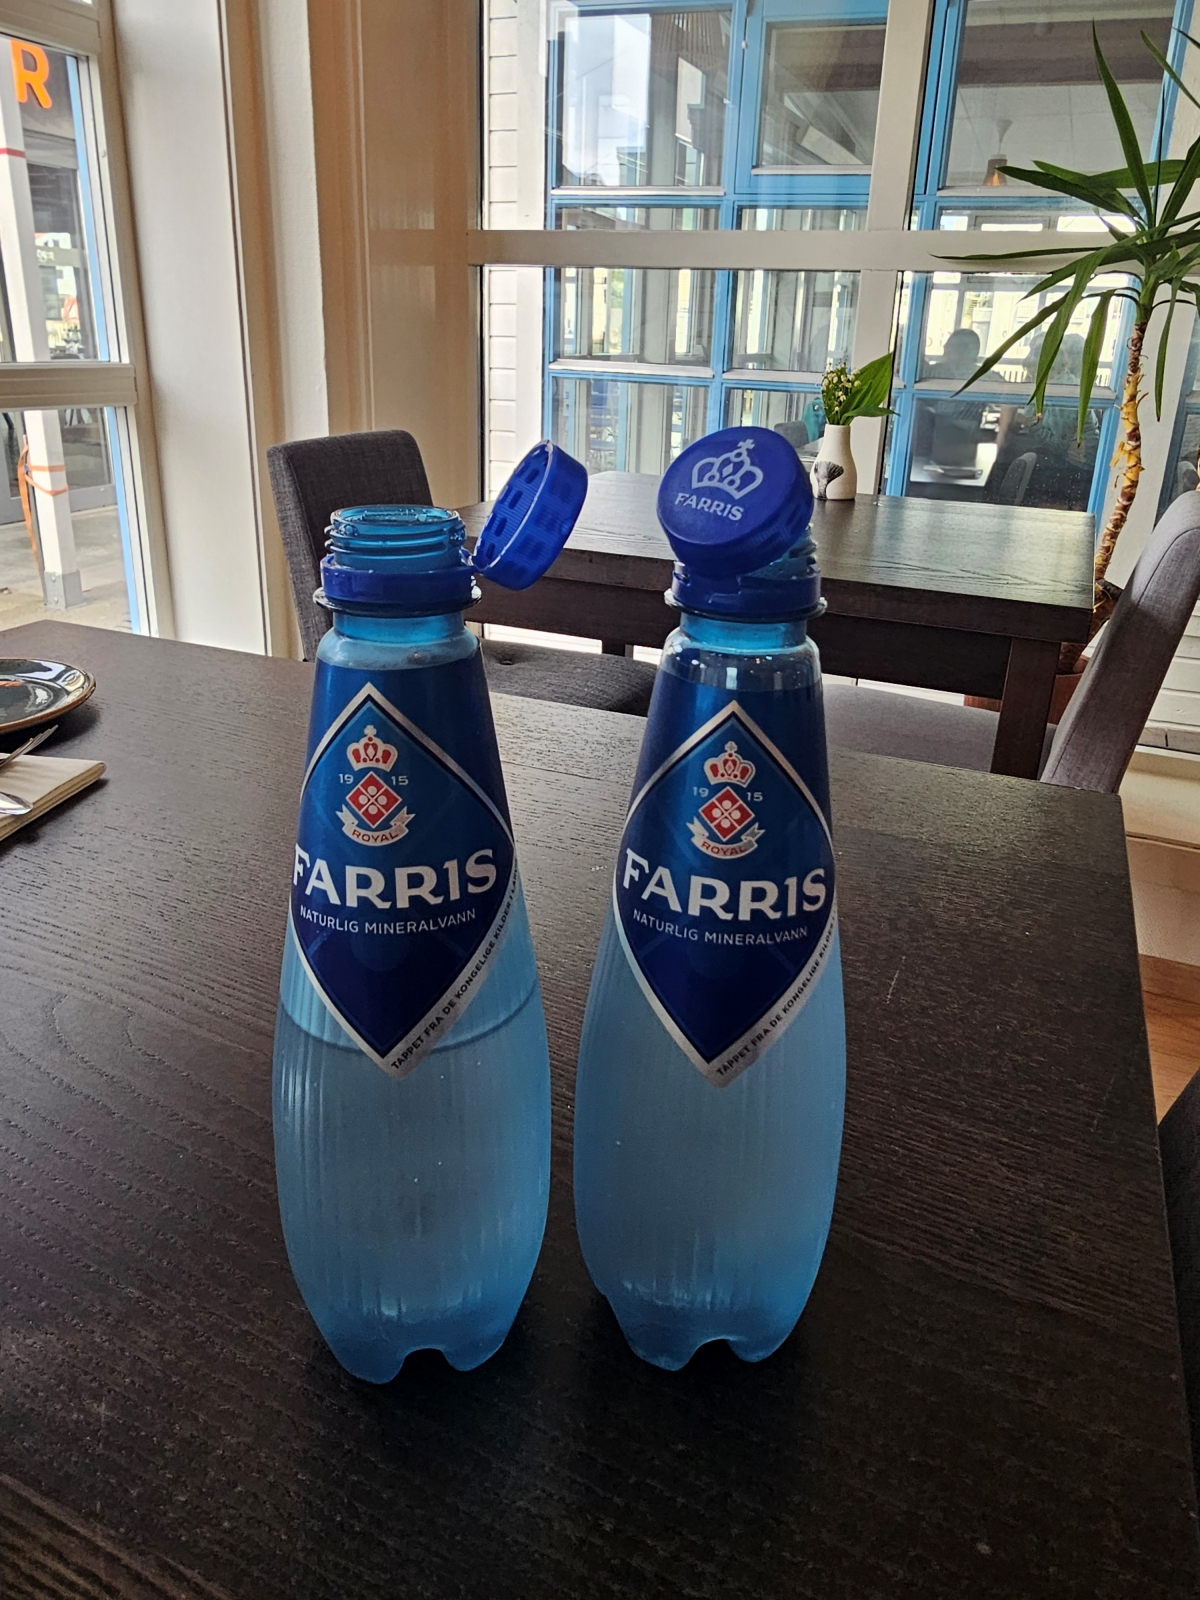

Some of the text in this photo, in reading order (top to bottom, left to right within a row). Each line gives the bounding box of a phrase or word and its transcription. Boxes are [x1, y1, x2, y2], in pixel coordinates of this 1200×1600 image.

[675, 492, 744, 521] FARRIS
[339, 774, 409, 786] 19 15
[693, 786, 763, 802] 19 15
[351, 829, 399, 843] ROYAL
[701, 840, 747, 856] ROYAL
[293, 843, 497, 908] FARRIS
[623, 847, 826, 921] FARRIS
[300, 904, 476, 935] NATURLIG MINERALVANN
[633, 908, 808, 946] NATURLIG MINERALVANN
[391, 1035, 425, 1069] TAPPET
[423, 1016, 444, 1037] FRA
[442, 999, 456, 1015] DE
[455, 941, 496, 999] KONGELIGE
[493, 901, 511, 940] KILDER
[716, 1045, 751, 1075] TAPPET
[750, 1028, 771, 1047] FRA
[769, 1014, 783, 1028] DE
[782, 959, 820, 1014] KONGELIGE
